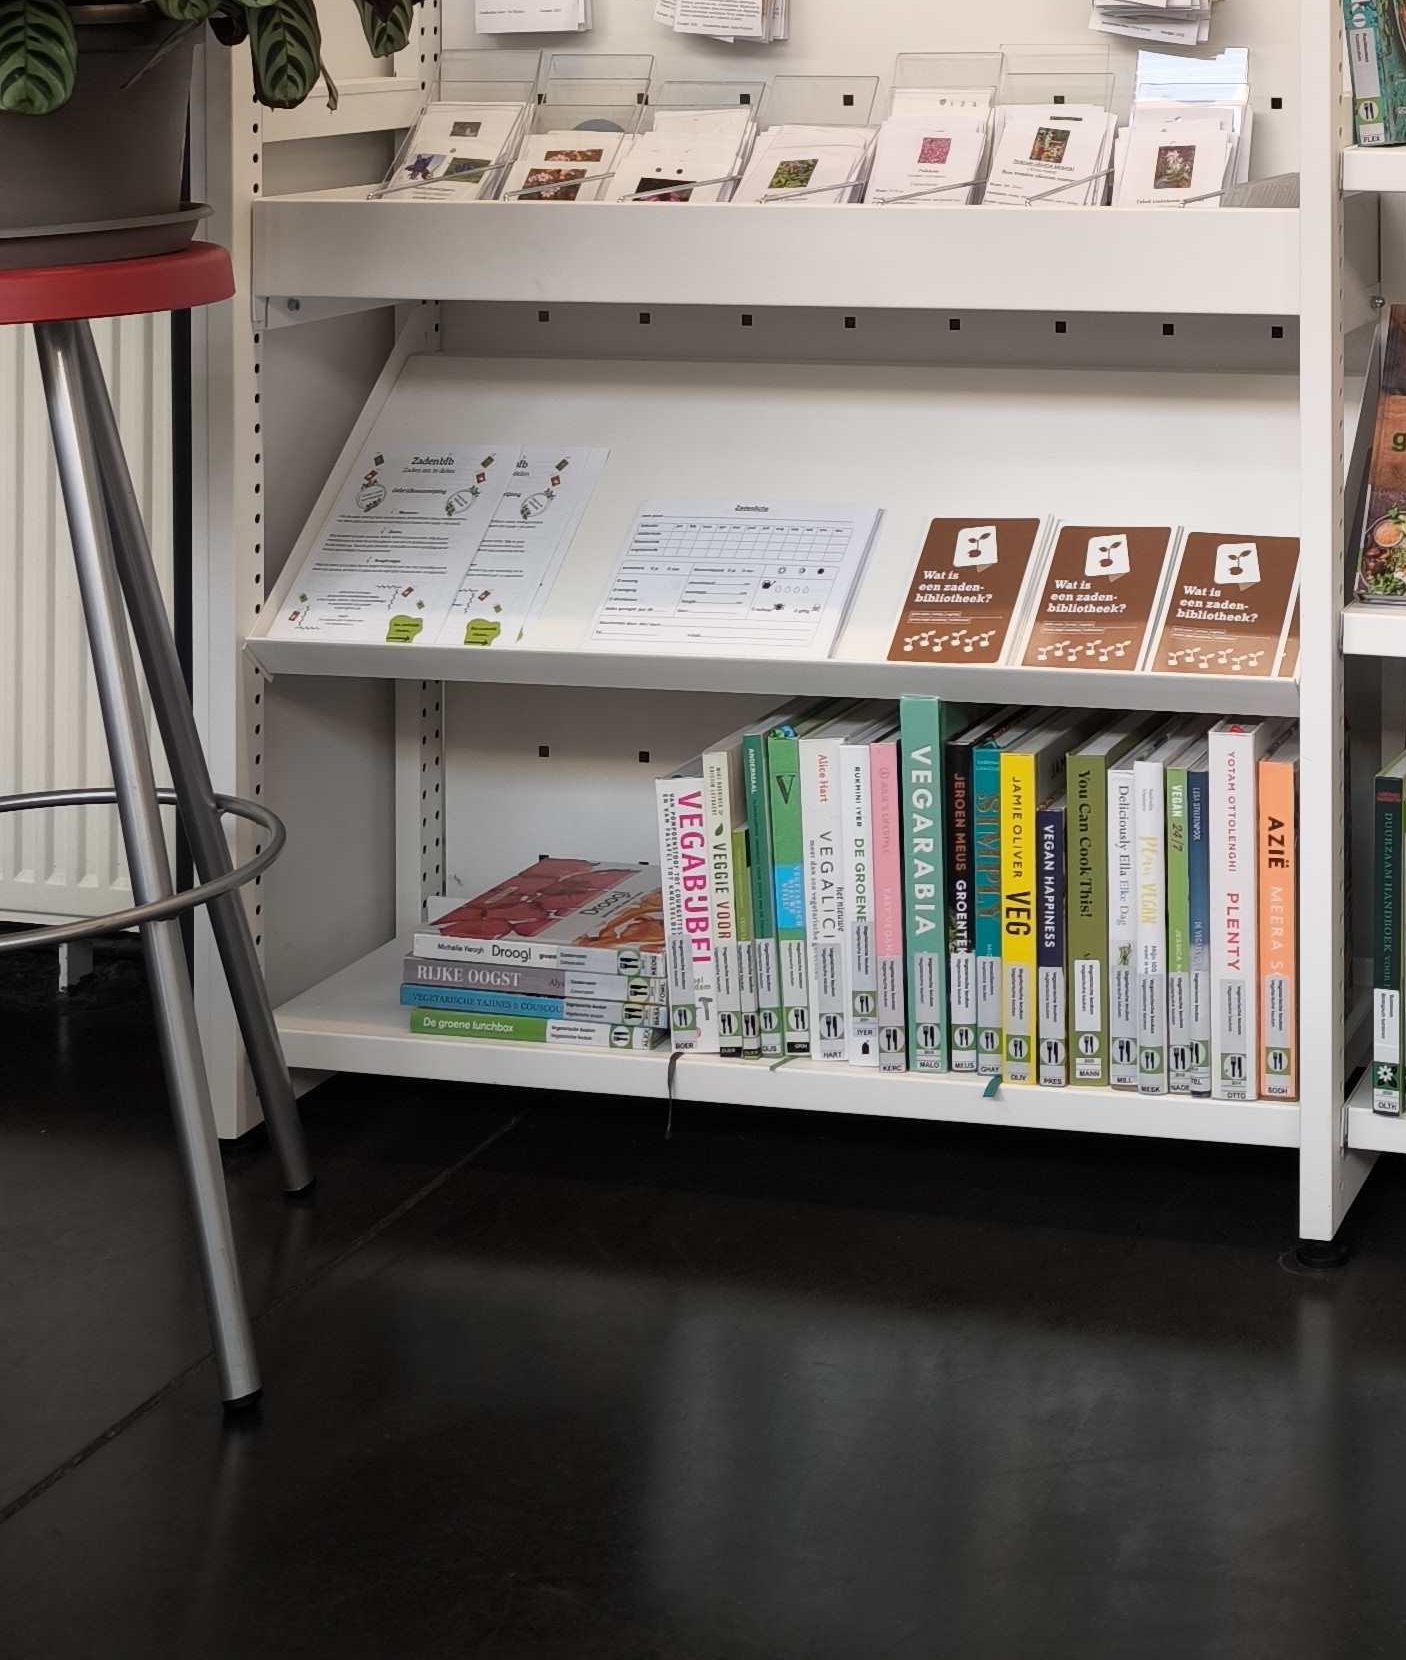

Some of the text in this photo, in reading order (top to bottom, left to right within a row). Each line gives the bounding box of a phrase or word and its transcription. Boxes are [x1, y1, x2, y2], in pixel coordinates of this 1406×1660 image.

[923, 570, 959, 580] Wat is
[919, 582, 984, 592] een zaden-
[1054, 579, 1091, 590] Wat is
[1183, 585, 1221, 597] Wat is
[914, 592, 992, 604] bibliotheek?
[1050, 591, 1118, 603] een zaden-
[1179, 598, 1249, 611] een zaden-
[1047, 602, 1126, 615] bibliotheek?
[1176, 608, 1258, 624] bibliotheek?
[953, 773, 966, 829] JEROEN
[910, 745, 936, 936] VEGARABIA
[1077, 770, 1093, 918] You Can Cook This!
[955, 832, 967, 871] MEUS
[1005, 776, 1032, 937] JAMIE OLIVER VEG
[1225, 751, 1241, 972] YOTAM OTTOLENGHI PLENTY
[1042, 824, 1055, 949] VEGAN HAPPINESS
[1267, 815, 1289, 952] AZIË MEERA
[491, 944, 532, 962] Droog!
[417, 965, 521, 987] RIJKE OOGST
[412, 992, 475, 1007] VEGETARISCHE
[423, 1017, 514, 1032] De groene lunchbox
[1378, 1102, 1397, 1110] OLTH
